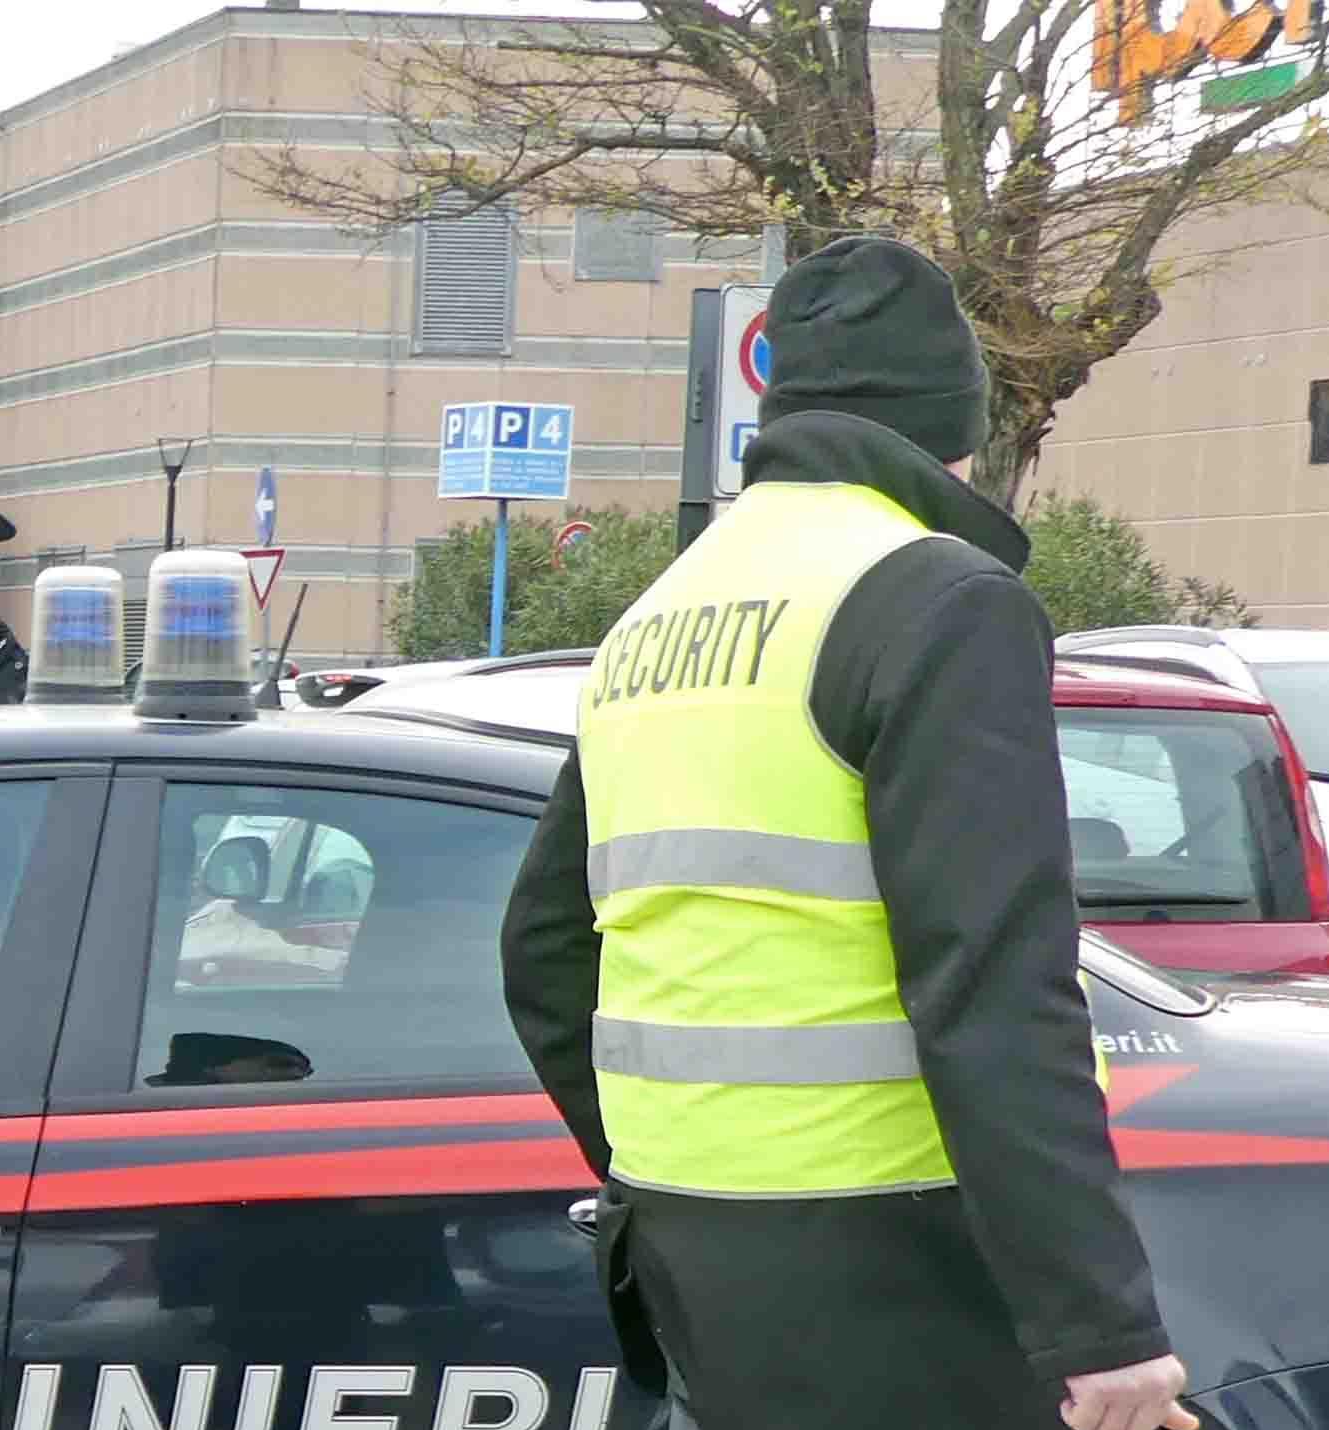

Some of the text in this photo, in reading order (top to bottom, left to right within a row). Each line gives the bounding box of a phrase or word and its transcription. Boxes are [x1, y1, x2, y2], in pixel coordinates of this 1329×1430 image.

[447, 411, 486, 445] P 4
[499, 411, 563, 446] P 4
[593, 599, 791, 710] SECURITY
